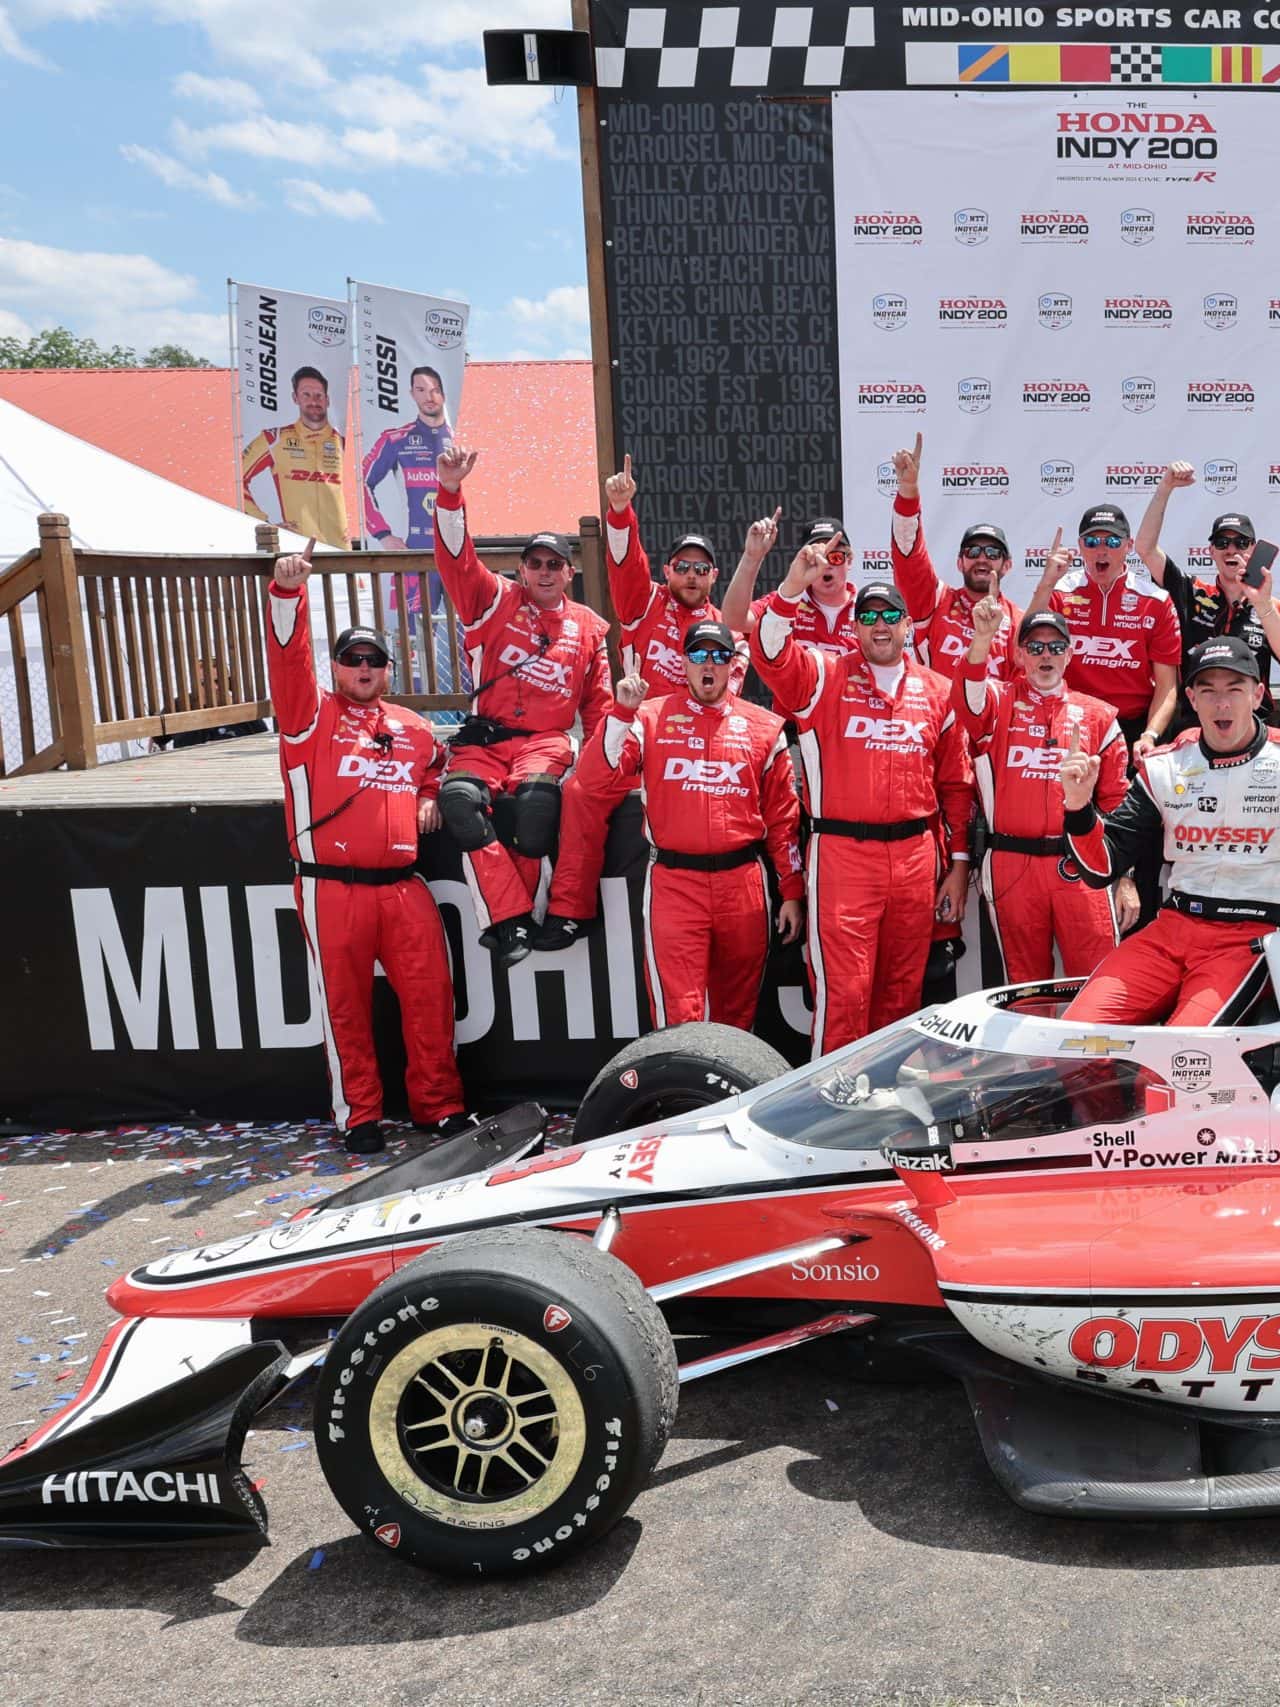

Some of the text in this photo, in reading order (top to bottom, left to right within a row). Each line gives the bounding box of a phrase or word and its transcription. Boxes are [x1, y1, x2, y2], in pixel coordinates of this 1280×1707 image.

[902, 8, 1044, 26] MID-OHIO
[1057, 8, 1172, 28] SPORTS
[1185, 9, 1241, 28] CAR
[1056, 113, 1217, 133] HONDA
[1056, 137, 1218, 159] INDY 200
[854, 215, 921, 225] HONDA
[1021, 214, 1088, 224] HONDA
[1187, 215, 1254, 225] HONDA
[853, 225, 923, 236] INDY 200
[1020, 225, 1089, 235] INDY 200
[1186, 225, 1255, 236] INDY 200
[939, 299, 1006, 309] HONDA
[1105, 298, 1171, 309] HONDA
[326, 315, 343, 324] NTT
[939, 309, 1007, 320] INDY 200
[1105, 309, 1173, 319] INDY 200
[442, 317, 460, 326] NTT
[308, 324, 345, 335] INDYCAR
[425, 326, 463, 337] INDYCAR
[258, 295, 278, 412] GROSJEAN
[376, 334, 399, 414] ROSSI
[859, 384, 925, 393] HONDA
[1023, 382, 1089, 392] HONDA
[1188, 383, 1252, 391] HONDA
[858, 394, 926, 404] INDY 200
[1023, 393, 1091, 403] INDY 200
[1187, 393, 1254, 402] INDY 200
[1113, 622, 1142, 630] HITACHI
[1070, 635, 1139, 660] DEX
[1082, 653, 1141, 669] imaging
[844, 716, 929, 744] DEX
[337, 755, 416, 782] DEX
[664, 758, 747, 784] DEX
[359, 778, 418, 796] imaging
[682, 780, 750, 797] imaging
[1244, 794, 1276, 802] verizon
[1174, 824, 1276, 845] ODYSSEY
[1176, 841, 1269, 854] BATTERY
[1189, 1057, 1208, 1066] NTT
[1172, 1069, 1211, 1077] INDYCAR
[1092, 1130, 1135, 1147] Shell
[883, 1146, 951, 1171] Mazak
[1094, 1149, 1207, 1169] V-Power
[886, 1199, 947, 1252] Firestone
[791, 1256, 880, 1281] Sonsio
[328, 1297, 440, 1442] Firestone
[42, 1471, 221, 1504] HITACHI
[512, 1417, 623, 1561] Firestone
[446, 1516, 506, 1530] RACING
